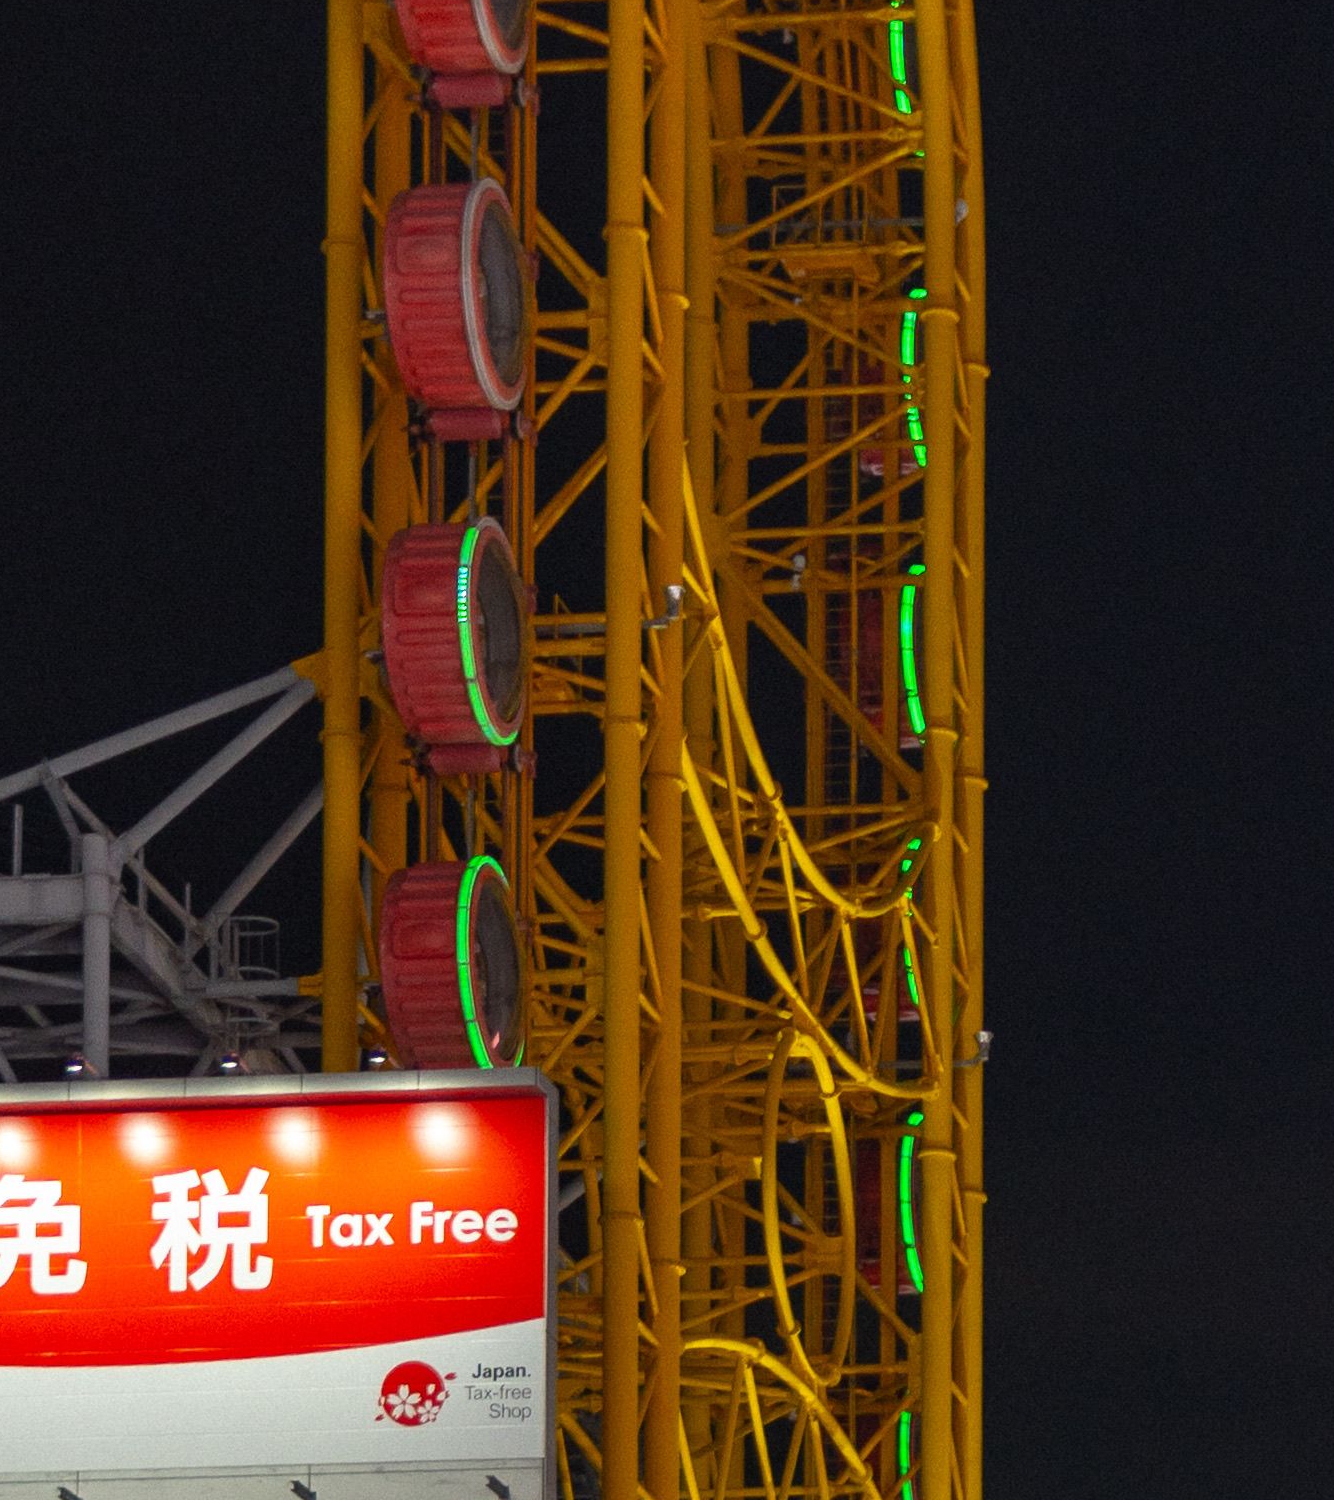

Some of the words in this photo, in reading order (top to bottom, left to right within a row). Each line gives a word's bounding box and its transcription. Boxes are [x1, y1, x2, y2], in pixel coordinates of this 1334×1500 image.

[149, 1167, 273, 1293] 税
[305, 1204, 394, 1248] Tax
[409, 1201, 519, 1245] Free
[471, 1363, 532, 1381] Japan.
[464, 1384, 532, 1401] Tax-free
[488, 1402, 532, 1420] Shop
